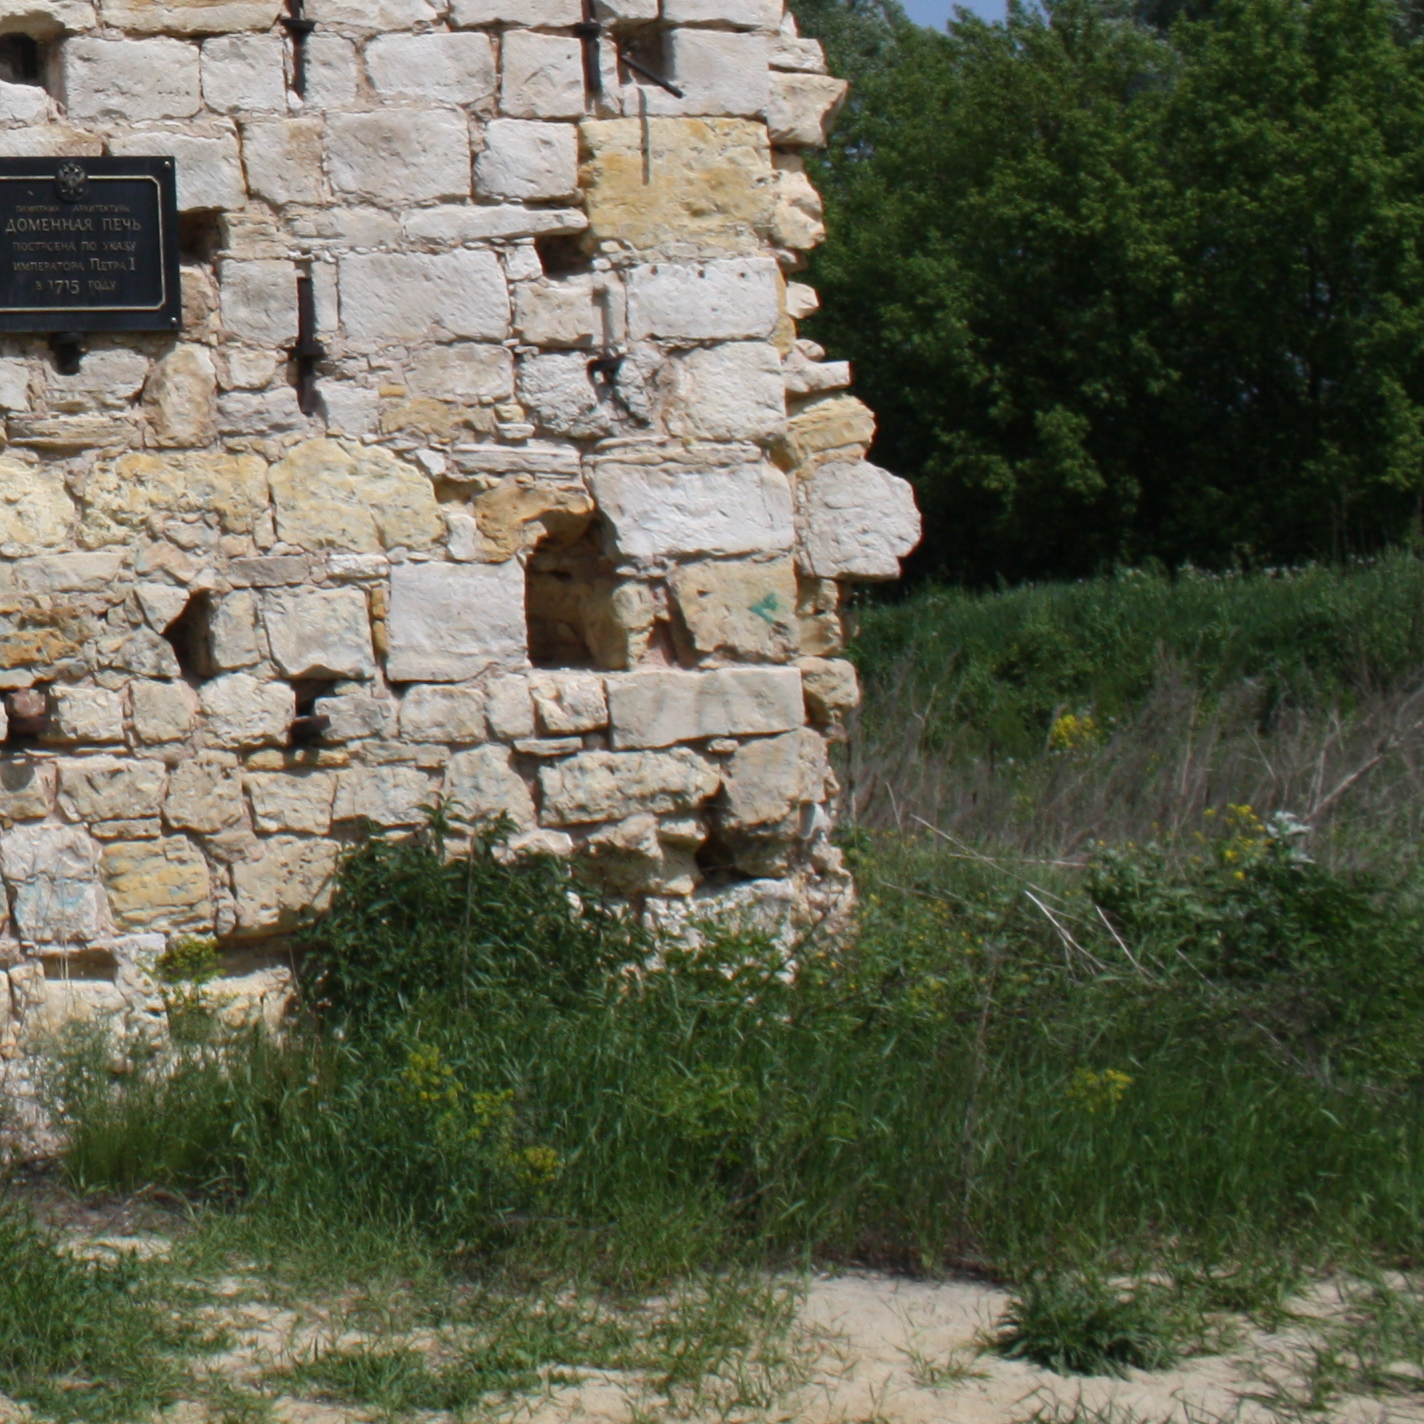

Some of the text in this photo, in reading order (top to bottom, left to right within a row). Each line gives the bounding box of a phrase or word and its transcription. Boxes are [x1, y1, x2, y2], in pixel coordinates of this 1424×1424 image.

[5, 218, 141, 233] ДОМЕННАЯ ПЕЧЬ
[12, 241, 137, 252] ПОСТРОЕНА ПО УКАЗУ
[12, 261, 85, 272] ИМПЕРАТОРА
[128, 257, 137, 271] I
[47, 279, 80, 295] 1715
[88, 280, 117, 291] ГОДУ
